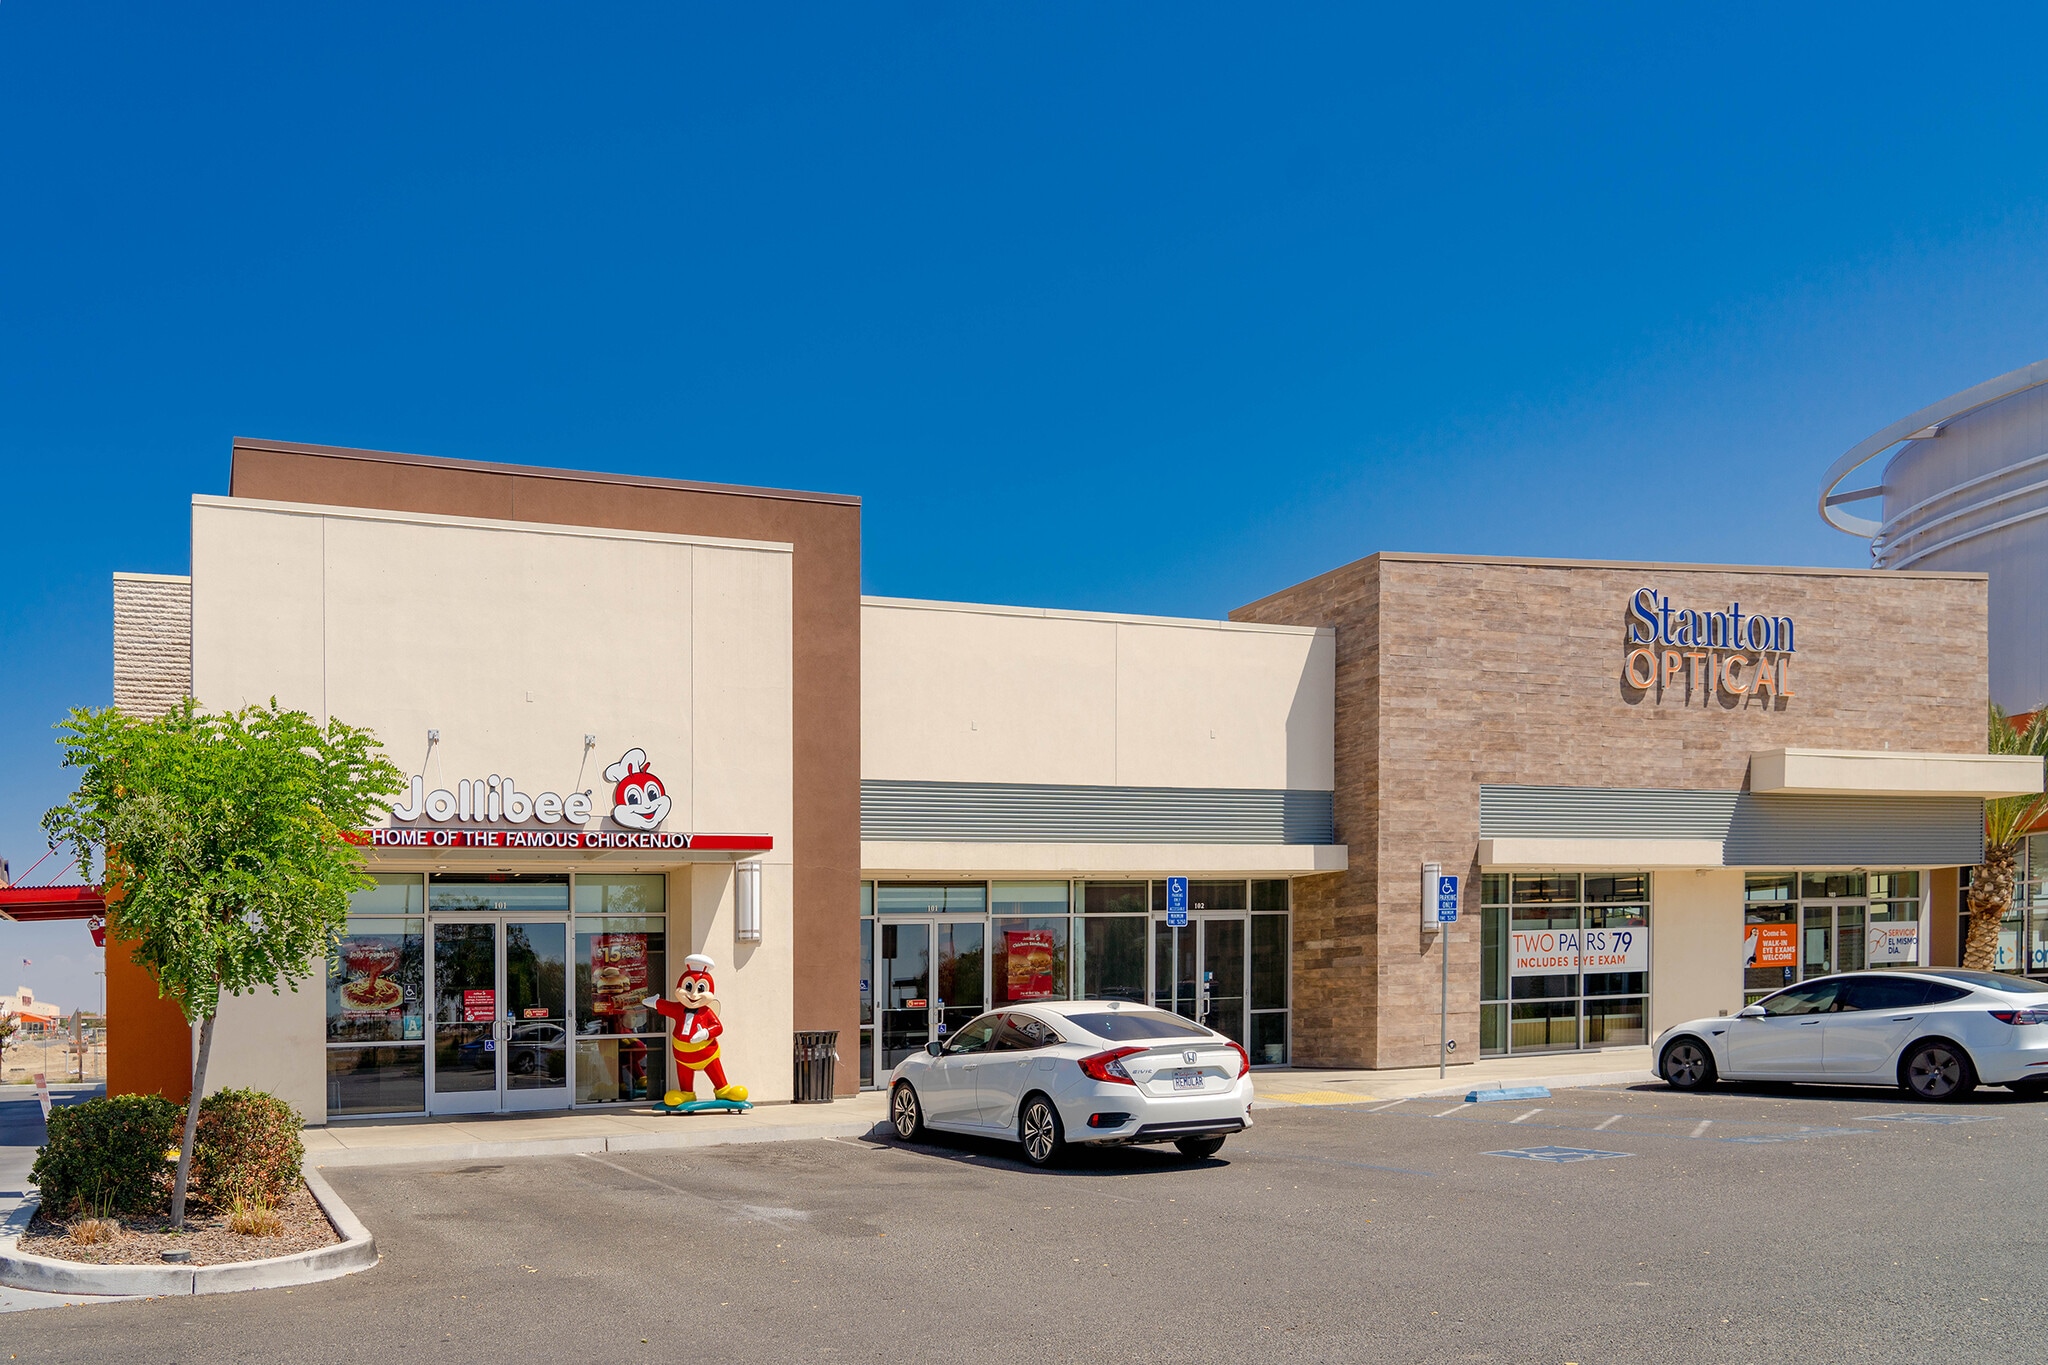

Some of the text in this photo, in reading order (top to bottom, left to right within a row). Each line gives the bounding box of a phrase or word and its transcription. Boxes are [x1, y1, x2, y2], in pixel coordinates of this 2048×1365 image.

[1629, 587, 1796, 652] Stanton
[1625, 648, 1795, 697] OPTICAL
[393, 773, 592, 825] Jollibee
[372, 829, 695, 849] HOME OF THE FAMOUS CHICKENJOY
[494, 901, 507, 910] 101
[1888, 928, 1916, 937] SERVICIO
[1512, 933, 1555, 953] TWO
[1559, 932, 1606, 952] PARS
[1762, 939, 1788, 947] WALK-IN
[1888, 936, 1918, 945] EL MISMO
[597, 945, 621, 963] $15
[1517, 956, 1569, 969] INCLUDES
[1598, 954, 1626, 965] EXAM
[1762, 953, 1792, 961] WELCOME
[408, 1020, 418, 1031] A
